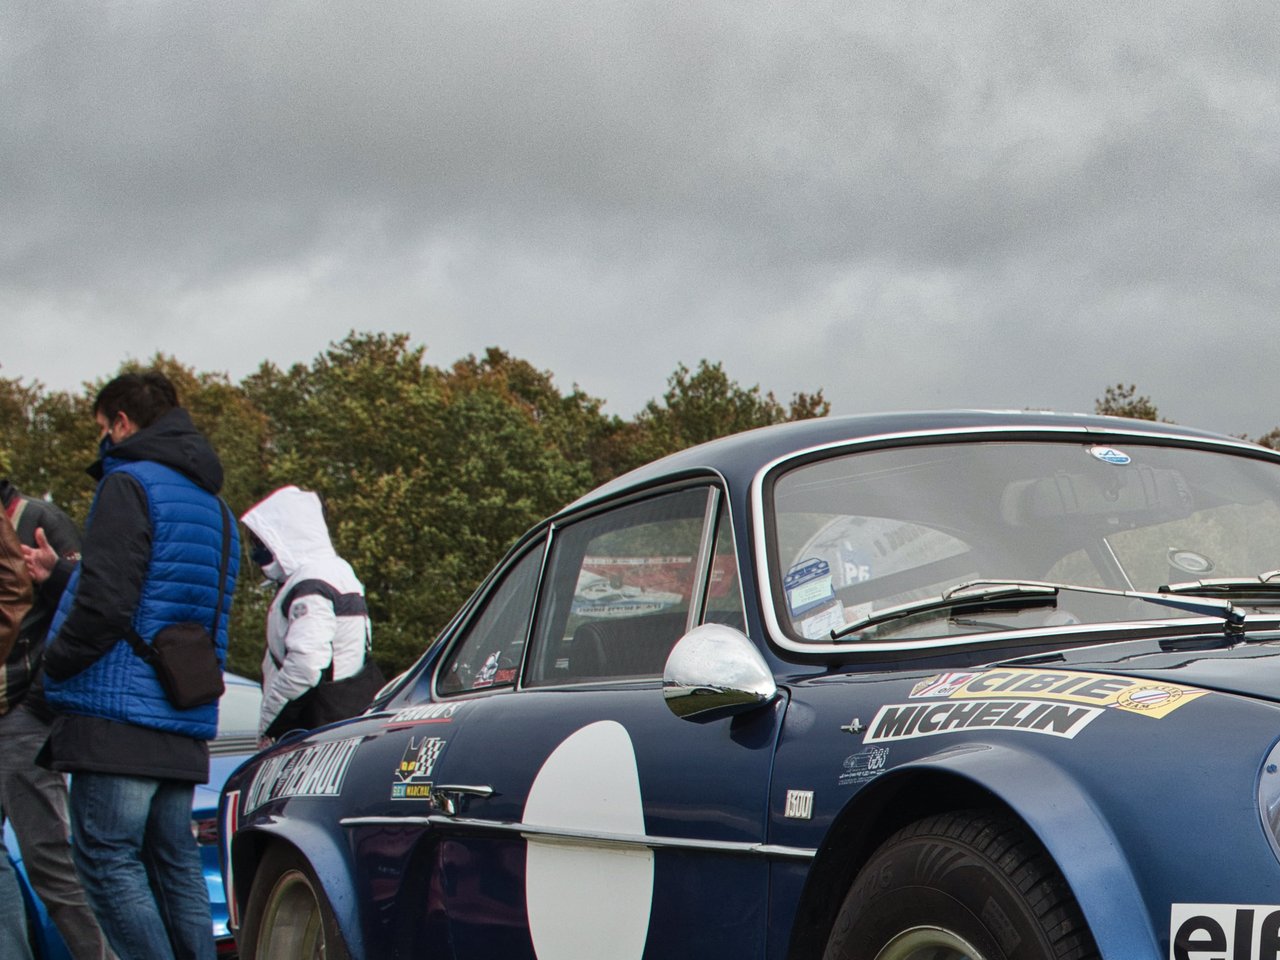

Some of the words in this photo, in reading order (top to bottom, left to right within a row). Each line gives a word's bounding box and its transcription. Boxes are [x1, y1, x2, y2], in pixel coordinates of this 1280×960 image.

[871, 701, 1092, 739] MICHELIN
[278, 737, 365, 795] RENAULT
[407, 785, 430, 796] MARCHAL
